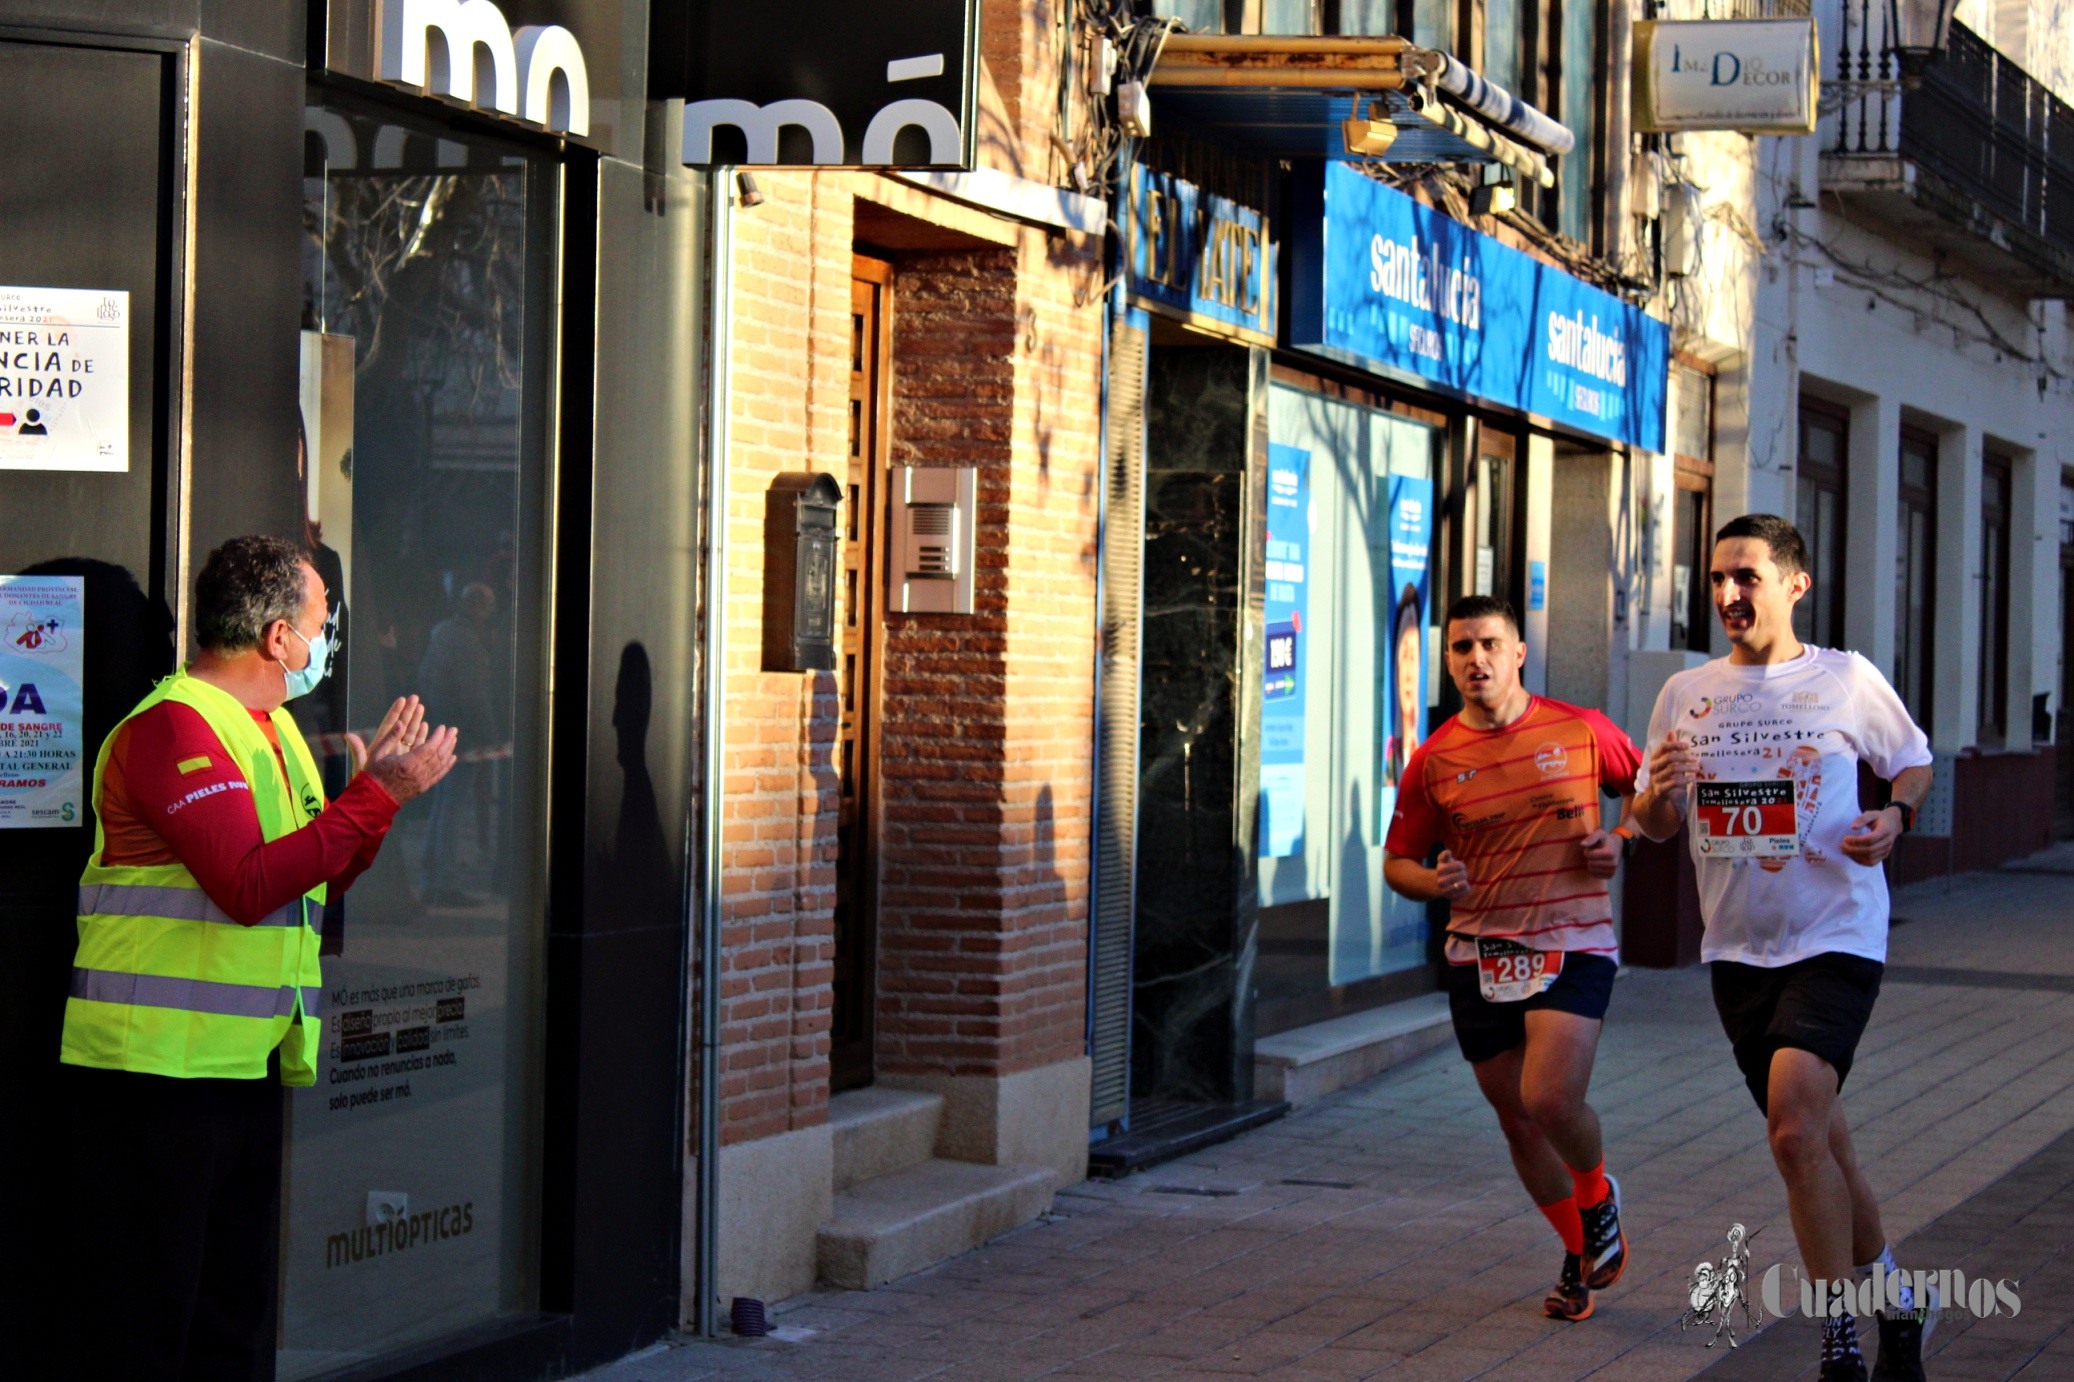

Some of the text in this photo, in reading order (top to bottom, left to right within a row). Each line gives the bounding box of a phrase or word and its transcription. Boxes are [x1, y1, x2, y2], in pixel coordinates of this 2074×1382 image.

[48, 332, 69, 346] LA
[72, 359, 94, 374] DE
[1714, 693, 1753, 704] GRUPO
[1712, 702, 1762, 715] SURCO
[0, 723, 63, 731] DE SANGRE
[1718, 719, 1793, 729] GRUPO SURCO
[1690, 730, 1825, 748] San Silvestre
[40, 750, 76, 758] HORAS
[22, 762, 73, 770] GENERAL
[167, 799, 186, 814] CAA
[185, 782, 227, 803] PIELES
[1701, 787, 1787, 798] San Silvestre
[1721, 806, 1762, 836] 70
[1497, 953, 1545, 983] 289
[330, 1063, 365, 1085] Cuando
[367, 1065, 379, 1078] no
[381, 1055, 423, 1077] renuncias
[425, 1058, 431, 1068] a
[329, 1092, 348, 1111] solo
[350, 1086, 378, 1112] puede
[380, 1086, 394, 1101] ser
